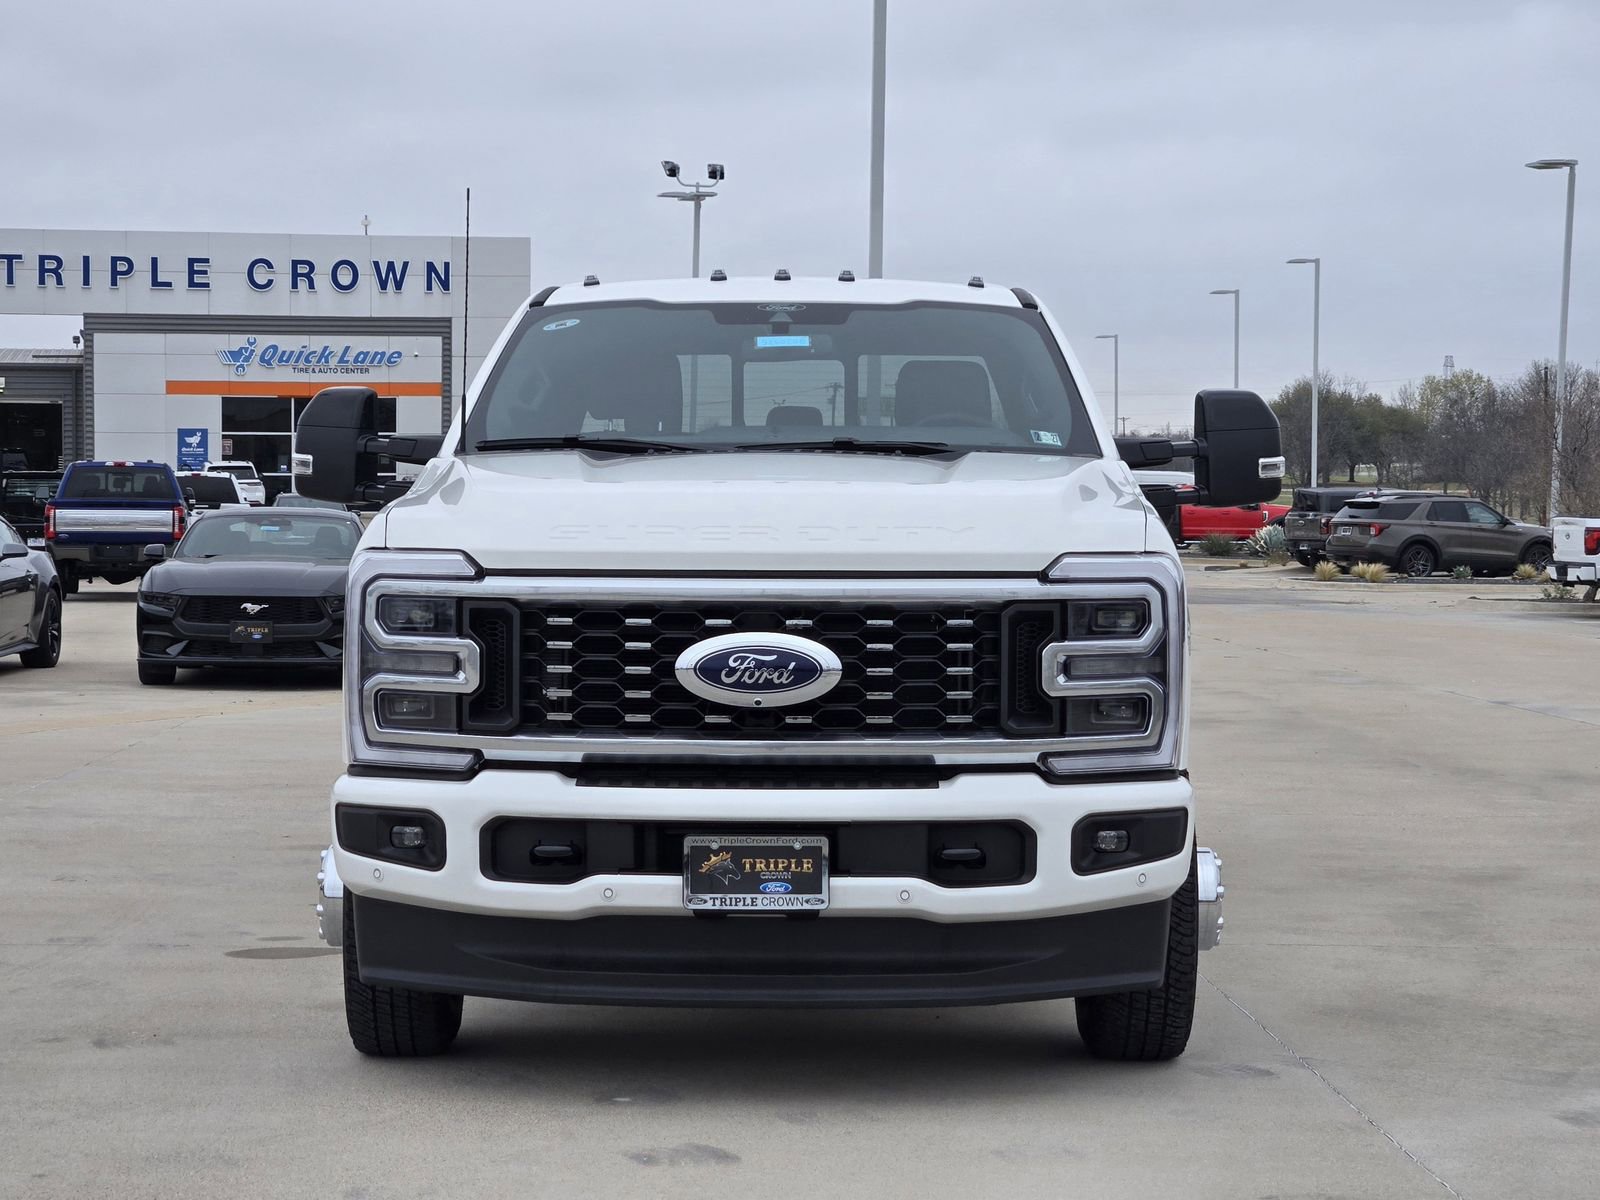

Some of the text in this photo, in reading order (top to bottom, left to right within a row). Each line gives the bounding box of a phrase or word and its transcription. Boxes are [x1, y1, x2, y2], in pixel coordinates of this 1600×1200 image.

[0, 253, 451, 293] TRIPLE CROWN
[258, 344, 403, 367] Quick Lane
[340, 367, 370, 375] CENTER
[720, 653, 796, 684] Ford
[742, 858, 813, 873] TRIPLE
[760, 872, 792, 880] CROWN
[765, 882, 786, 893] Ford
[709, 896, 758, 907] TRIPLE
[760, 896, 804, 907] CROWN
